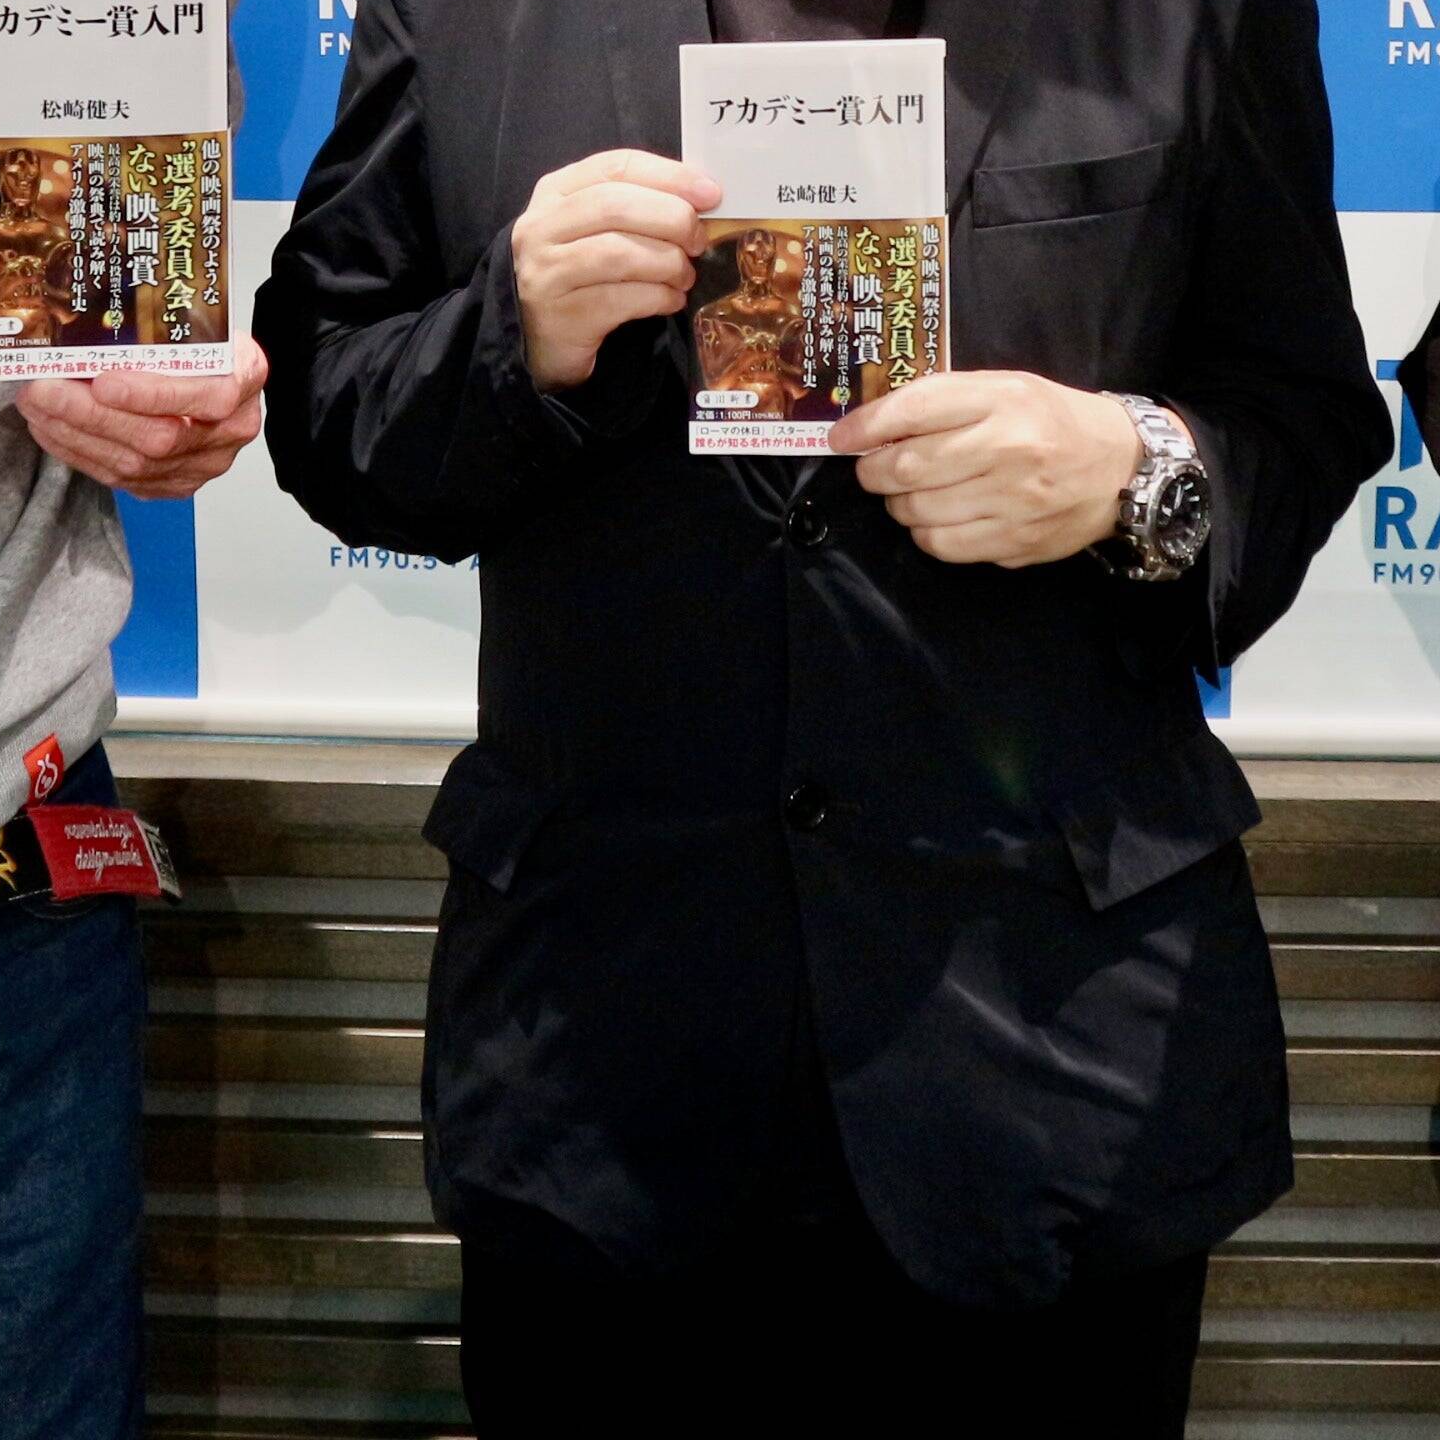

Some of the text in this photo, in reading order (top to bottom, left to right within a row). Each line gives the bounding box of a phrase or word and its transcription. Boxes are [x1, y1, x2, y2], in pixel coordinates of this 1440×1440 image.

[40, 99, 130, 120] 松崎健夫
[709, 94, 924, 126] アカデミー賞入門
[69, 143, 88, 312] アメリカ激動の100年史
[87, 143, 107, 289] 映画の祭典で読み解く
[125, 144, 160, 287] ない映画賞
[201, 139, 222, 305] 他の映画祭のような
[777, 184, 857, 204] 松崎健夫
[818, 226, 835, 367] 映画の祭典で読み解く
[852, 226, 884, 365] ない映画賞
[695, 437, 827, 448] 誰もが知る名作が作品賞を
